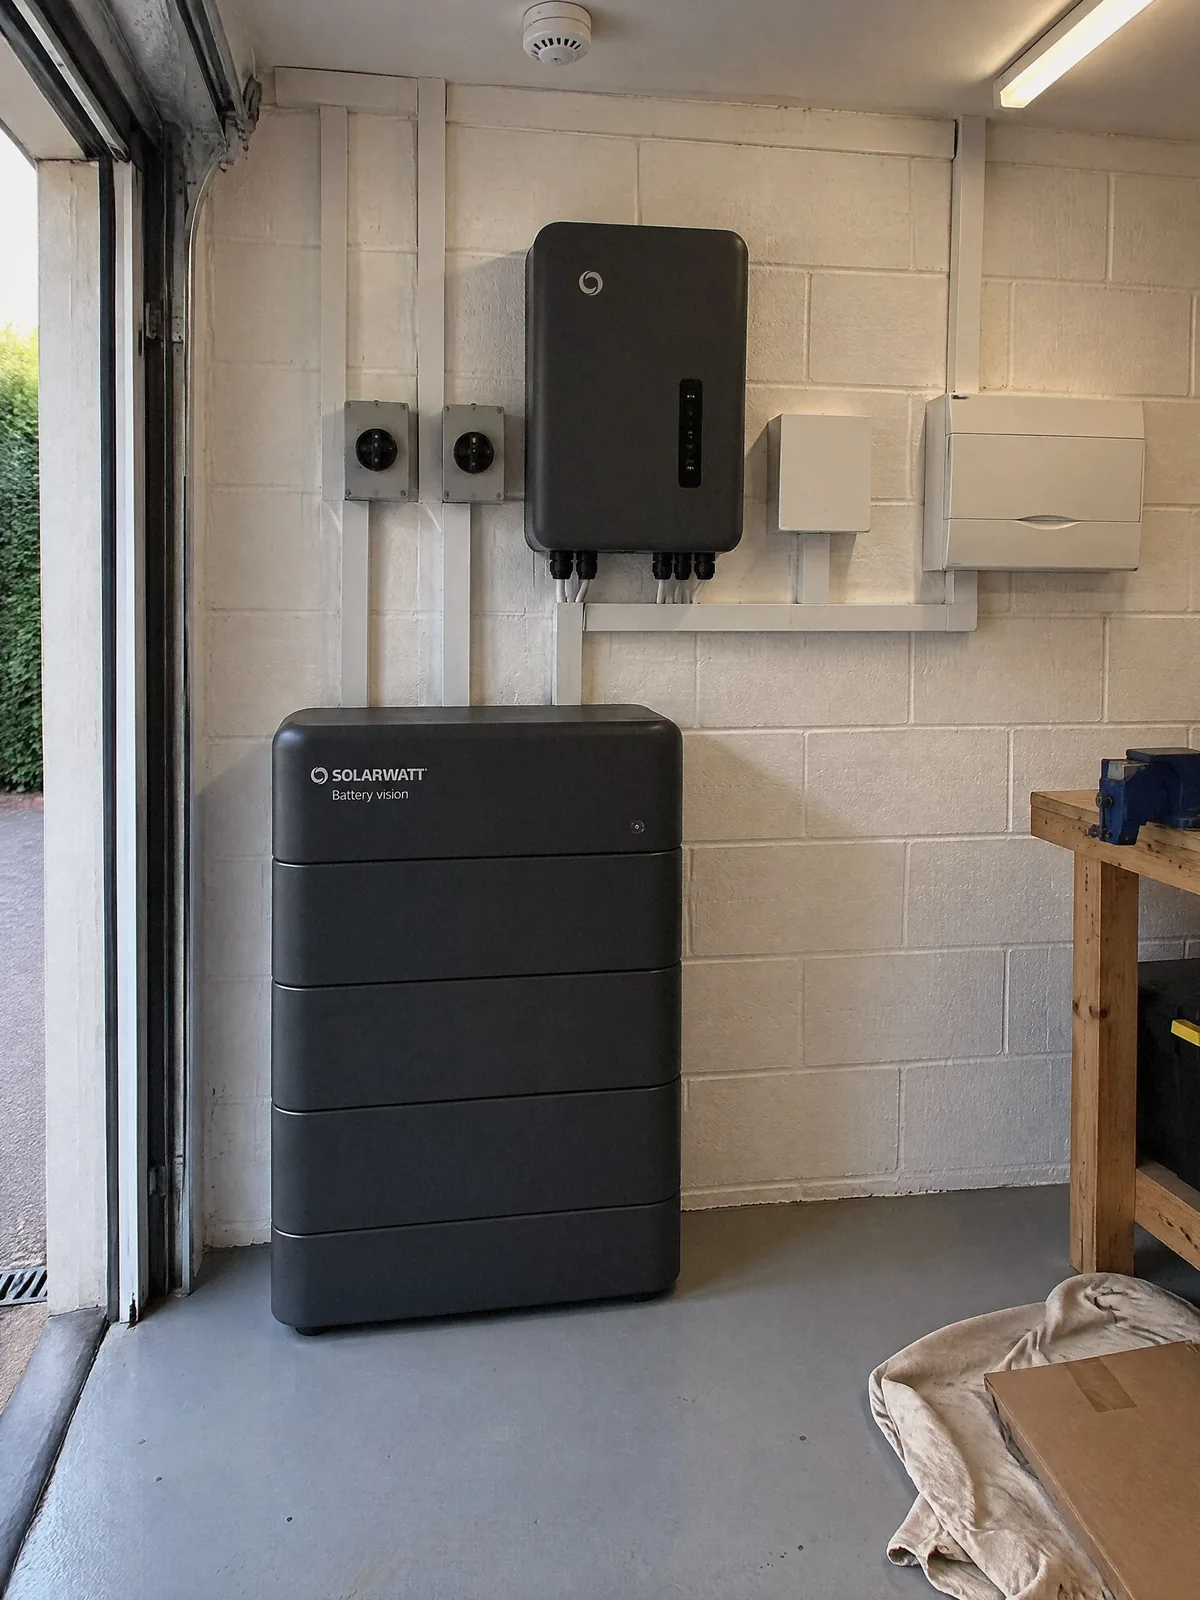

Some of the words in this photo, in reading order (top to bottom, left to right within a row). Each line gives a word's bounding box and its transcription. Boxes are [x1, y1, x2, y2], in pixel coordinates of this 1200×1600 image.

[332, 768, 425, 782] SOLARWATT
[332, 789, 373, 803] Battery
[376, 788, 409, 800] vision
